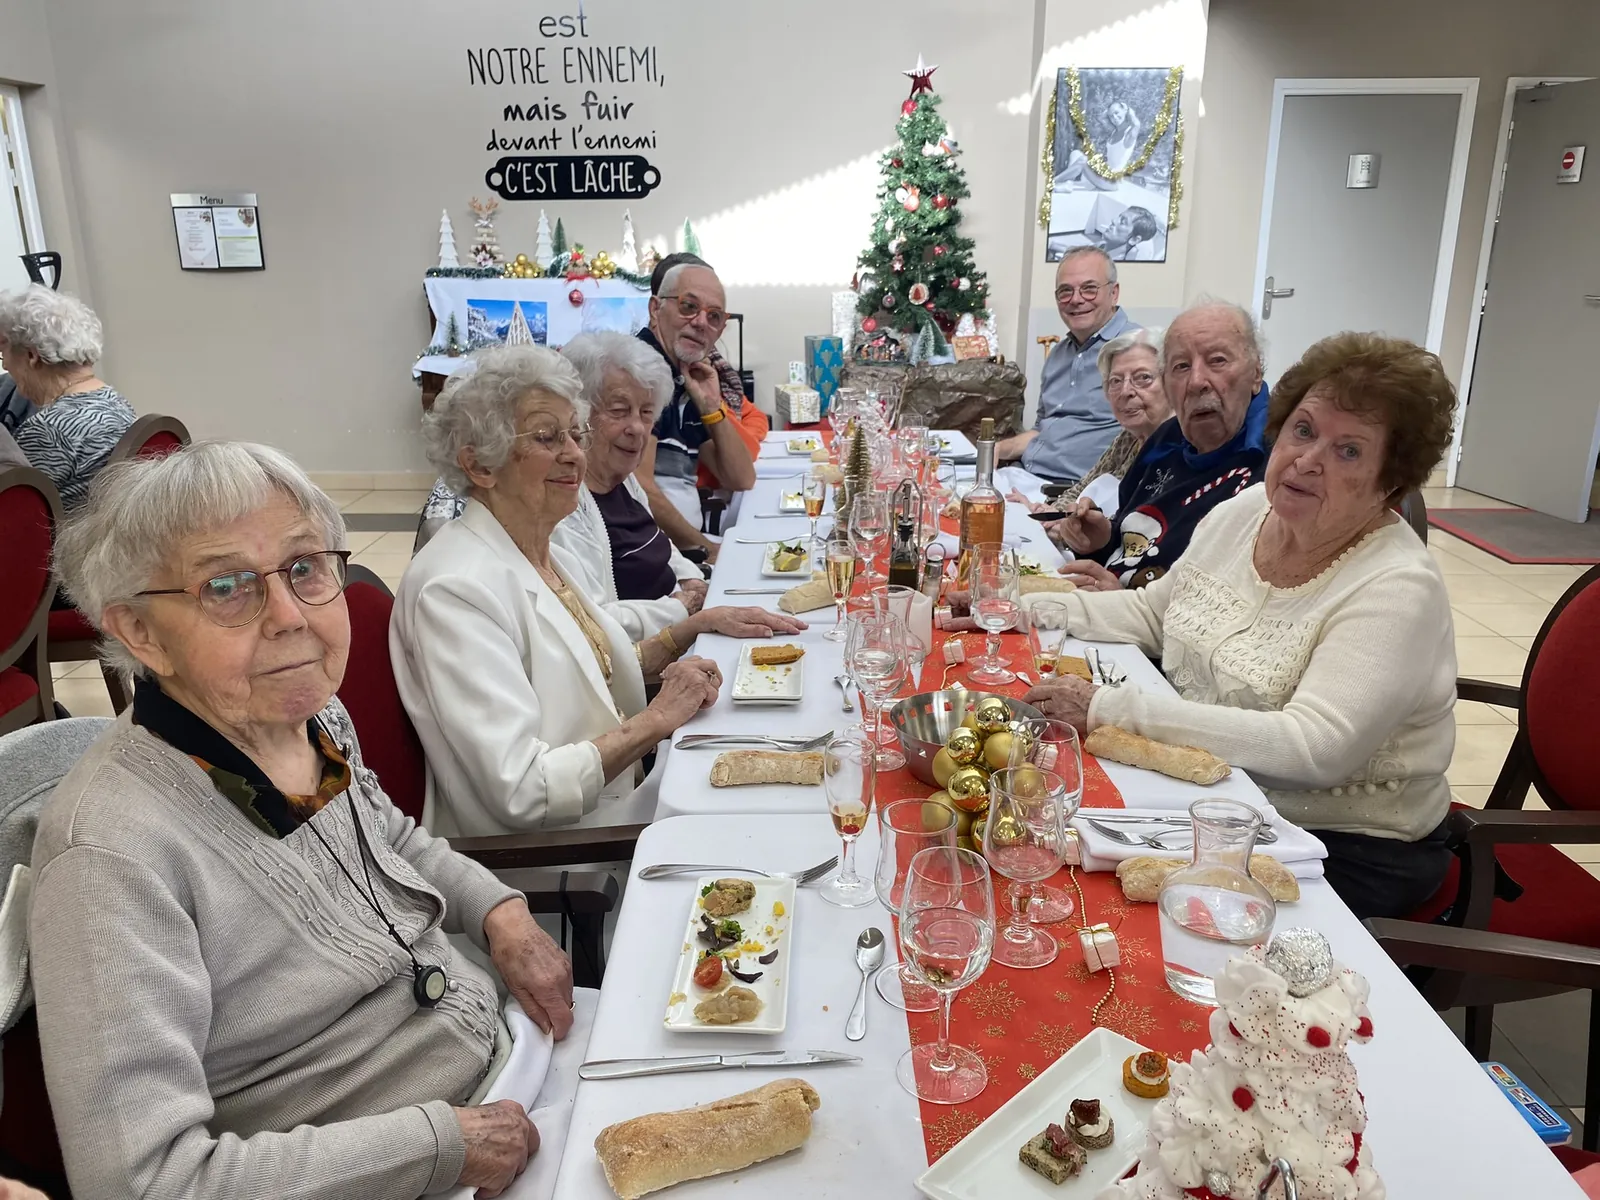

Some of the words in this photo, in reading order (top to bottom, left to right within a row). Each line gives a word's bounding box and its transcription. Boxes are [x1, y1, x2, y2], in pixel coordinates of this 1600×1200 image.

[539, 8, 589, 38] est
[467, 47, 550, 85] NOTRE
[563, 46, 665, 87] ENNEMI,
[503, 96, 567, 121] mais
[580, 90, 634, 121] fuir
[486, 128, 562, 151] devant
[572, 124, 657, 150] l'ennemi
[505, 162, 558, 193] C'EST
[570, 159, 642, 193] LÂCHE.
[199, 196, 224, 205] Menu
